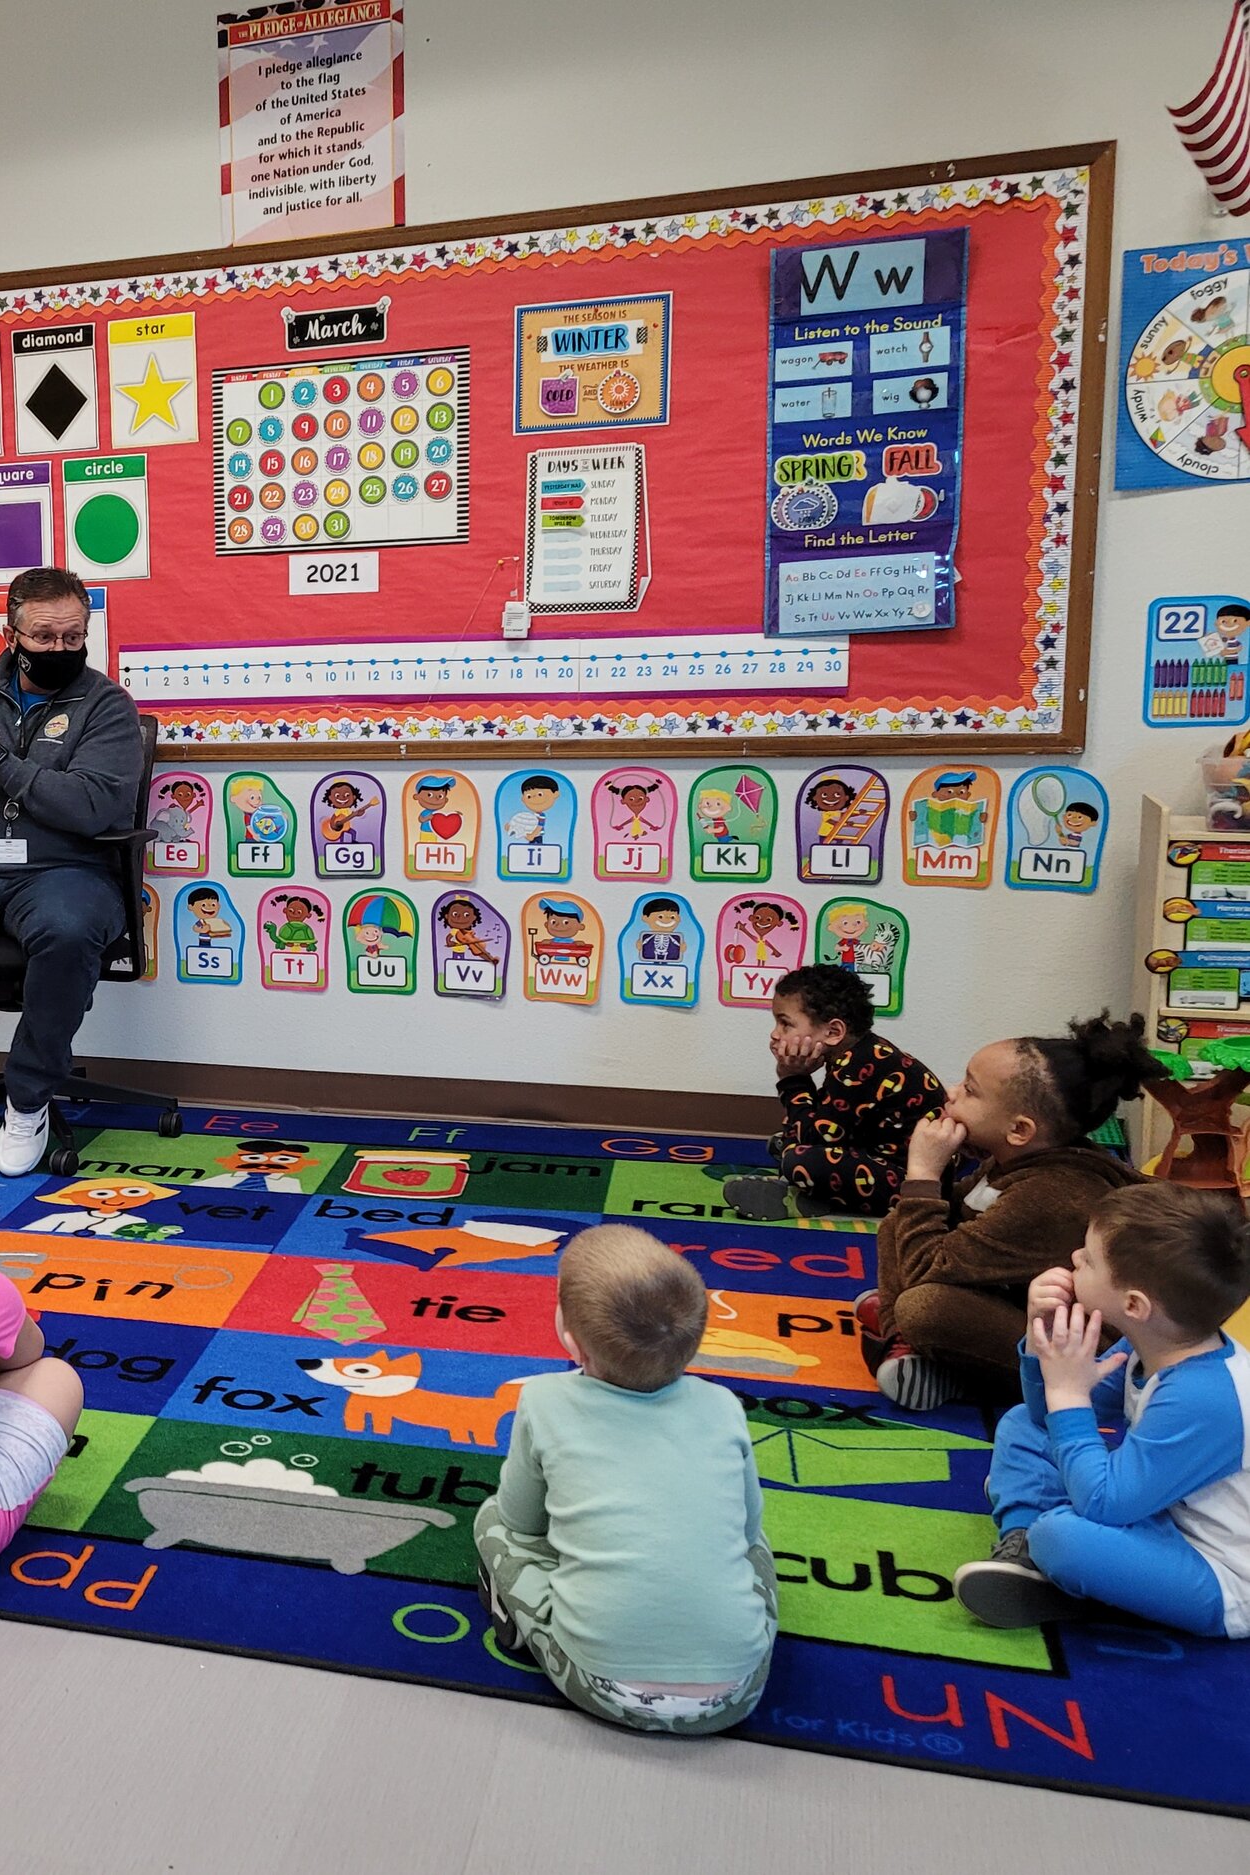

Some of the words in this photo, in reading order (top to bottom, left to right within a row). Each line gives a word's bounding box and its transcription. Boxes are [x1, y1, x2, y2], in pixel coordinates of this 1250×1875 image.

[249, 17, 296, 40] PLEDGE
[303, 4, 382, 29] ALLEGIANCE
[258, 65, 263, 76] I
[265, 62, 302, 77] pledge
[306, 51, 363, 70] allegiance
[281, 80, 292, 89] to
[297, 76, 314, 87] the
[318, 73, 340, 85] flag
[255, 101, 267, 111] of
[272, 98, 289, 109] the
[292, 93, 328, 106] United
[332, 87, 366, 101] States
[280, 114, 291, 125] of
[295, 108, 341, 123] America
[258, 136, 277, 146] and
[281, 132, 292, 143] to
[296, 129, 313, 140] the
[317, 121, 365, 138] Republic
[259, 153, 274, 164] for
[279, 147, 310, 160] which
[314, 145, 322, 154] it
[327, 140, 365, 153] stands,
[251, 174, 270, 183] one
[274, 165, 309, 179] Nation
[312, 162, 345, 174] under
[349, 155, 374, 168] God,
[249, 182, 306, 200] indivisible,
[310, 177, 335, 191] with
[339, 173, 376, 186] liberty
[263, 205, 282, 215] and
[285, 200, 322, 215] justice
[326, 195, 342, 206] for
[346, 193, 363, 204] all.
[1140, 244, 1238, 273] Today's
[800, 251, 859, 303] W
[874, 266, 913, 295] w
[1190, 277, 1228, 300] foggy
[304, 311, 366, 341] March
[564, 315, 579, 323] THE
[582, 311, 615, 321] SEASON
[619, 310, 626, 318] IS
[136, 323, 165, 336] star
[794, 327, 839, 341] Listen
[844, 325, 860, 335] to
[865, 321, 888, 333] the
[894, 314, 942, 330] Sound
[1140, 316, 1170, 350] sunny
[22, 331, 83, 348] diamond
[555, 328, 627, 352] WINTER
[876, 344, 907, 355] watch
[559, 364, 574, 373] THE
[577, 362, 618, 372] WEATHER
[781, 356, 813, 366] wagon
[546, 390, 573, 401] COLD
[782, 400, 810, 408] water
[883, 394, 899, 402] wig
[1131, 389, 1147, 423] windy
[434, 412, 447, 423] 13
[803, 433, 851, 447] Words
[856, 430, 883, 443] We
[888, 427, 927, 440] Know
[85, 461, 124, 476] circle
[548, 460, 578, 473] DAYS
[592, 456, 625, 470] WEEK
[780, 455, 851, 482] SPRING
[889, 449, 934, 472] FALL
[1177, 453, 1219, 474] cloudy
[398, 482, 413, 494] 26
[431, 480, 446, 491] 27
[591, 480, 615, 488] SUNDAY
[265, 491, 279, 502] 22
[590, 497, 617, 505] MONDAY
[590, 513, 617, 522] TUESDAY
[590, 529, 627, 538] WEDNESDAY
[805, 535, 835, 547] Find
[840, 532, 865, 544] the
[869, 530, 917, 542] Letter
[590, 547, 622, 555] THURSDAY
[307, 563, 360, 583] 2021
[589, 564, 612, 572] FRIDAY
[589, 580, 621, 588] SATURDAY
[1165, 610, 1200, 634] 22
[325, 672, 336, 682] 10
[558, 668, 573, 678] 20
[166, 845, 187, 862] Ee
[252, 847, 269, 862] Ff
[335, 847, 365, 868] Gg
[425, 847, 455, 865] Hh
[527, 845, 541, 866] Ii
[622, 847, 643, 869] Jj
[716, 847, 747, 867] Kk
[831, 849, 849, 869] Ll
[923, 851, 972, 871] Mm
[1034, 854, 1071, 873] Nn
[198, 953, 220, 969] Ss
[286, 958, 305, 974] Tt
[366, 960, 395, 978] Uu
[457, 965, 483, 983] Vv
[540, 968, 582, 987] Ww
[644, 971, 673, 989] Xx
[745, 973, 774, 996] Yy
[78, 1159, 207, 1181] man
[464, 1157, 601, 1178] jam
[175, 1202, 281, 1222] vet
[314, 1200, 454, 1226] bed
[668, 1243, 864, 1279] red
[31, 1272, 174, 1301] pin
[411, 1296, 506, 1322] tie
[46, 1340, 175, 1381] dog
[193, 1377, 329, 1416] fox
[351, 1463, 497, 1509] tub
[775, 1551, 953, 1600] cub
